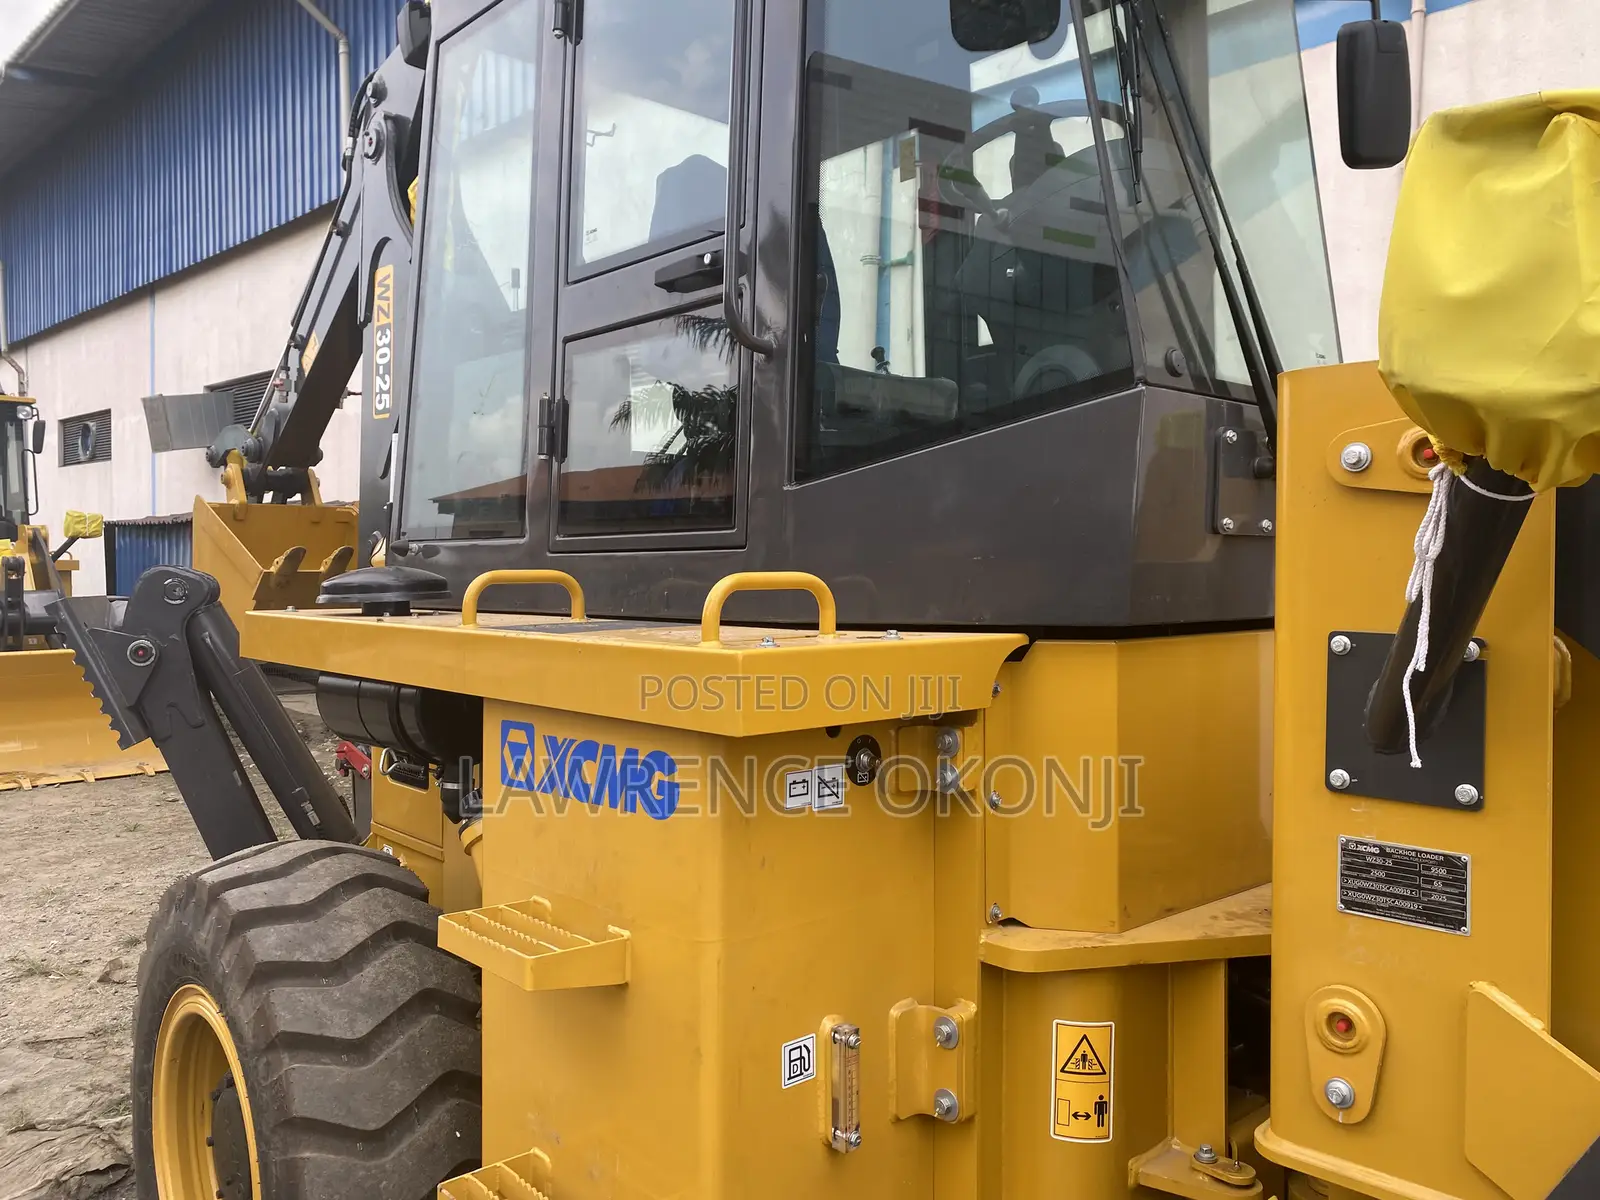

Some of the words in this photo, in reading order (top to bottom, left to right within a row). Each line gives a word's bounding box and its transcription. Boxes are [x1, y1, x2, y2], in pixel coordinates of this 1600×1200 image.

[535, 734, 680, 820] XCMG
[1357, 844, 1380, 854] XCMG
[1386, 847, 1416, 857] BACKHOE
[1417, 852, 1445, 861] LOADER
[1370, 869, 1386, 878] 2500
[1433, 880, 1443, 888] 65
[1431, 893, 1447, 902] 2025
[792, 1063, 799, 1075] D
